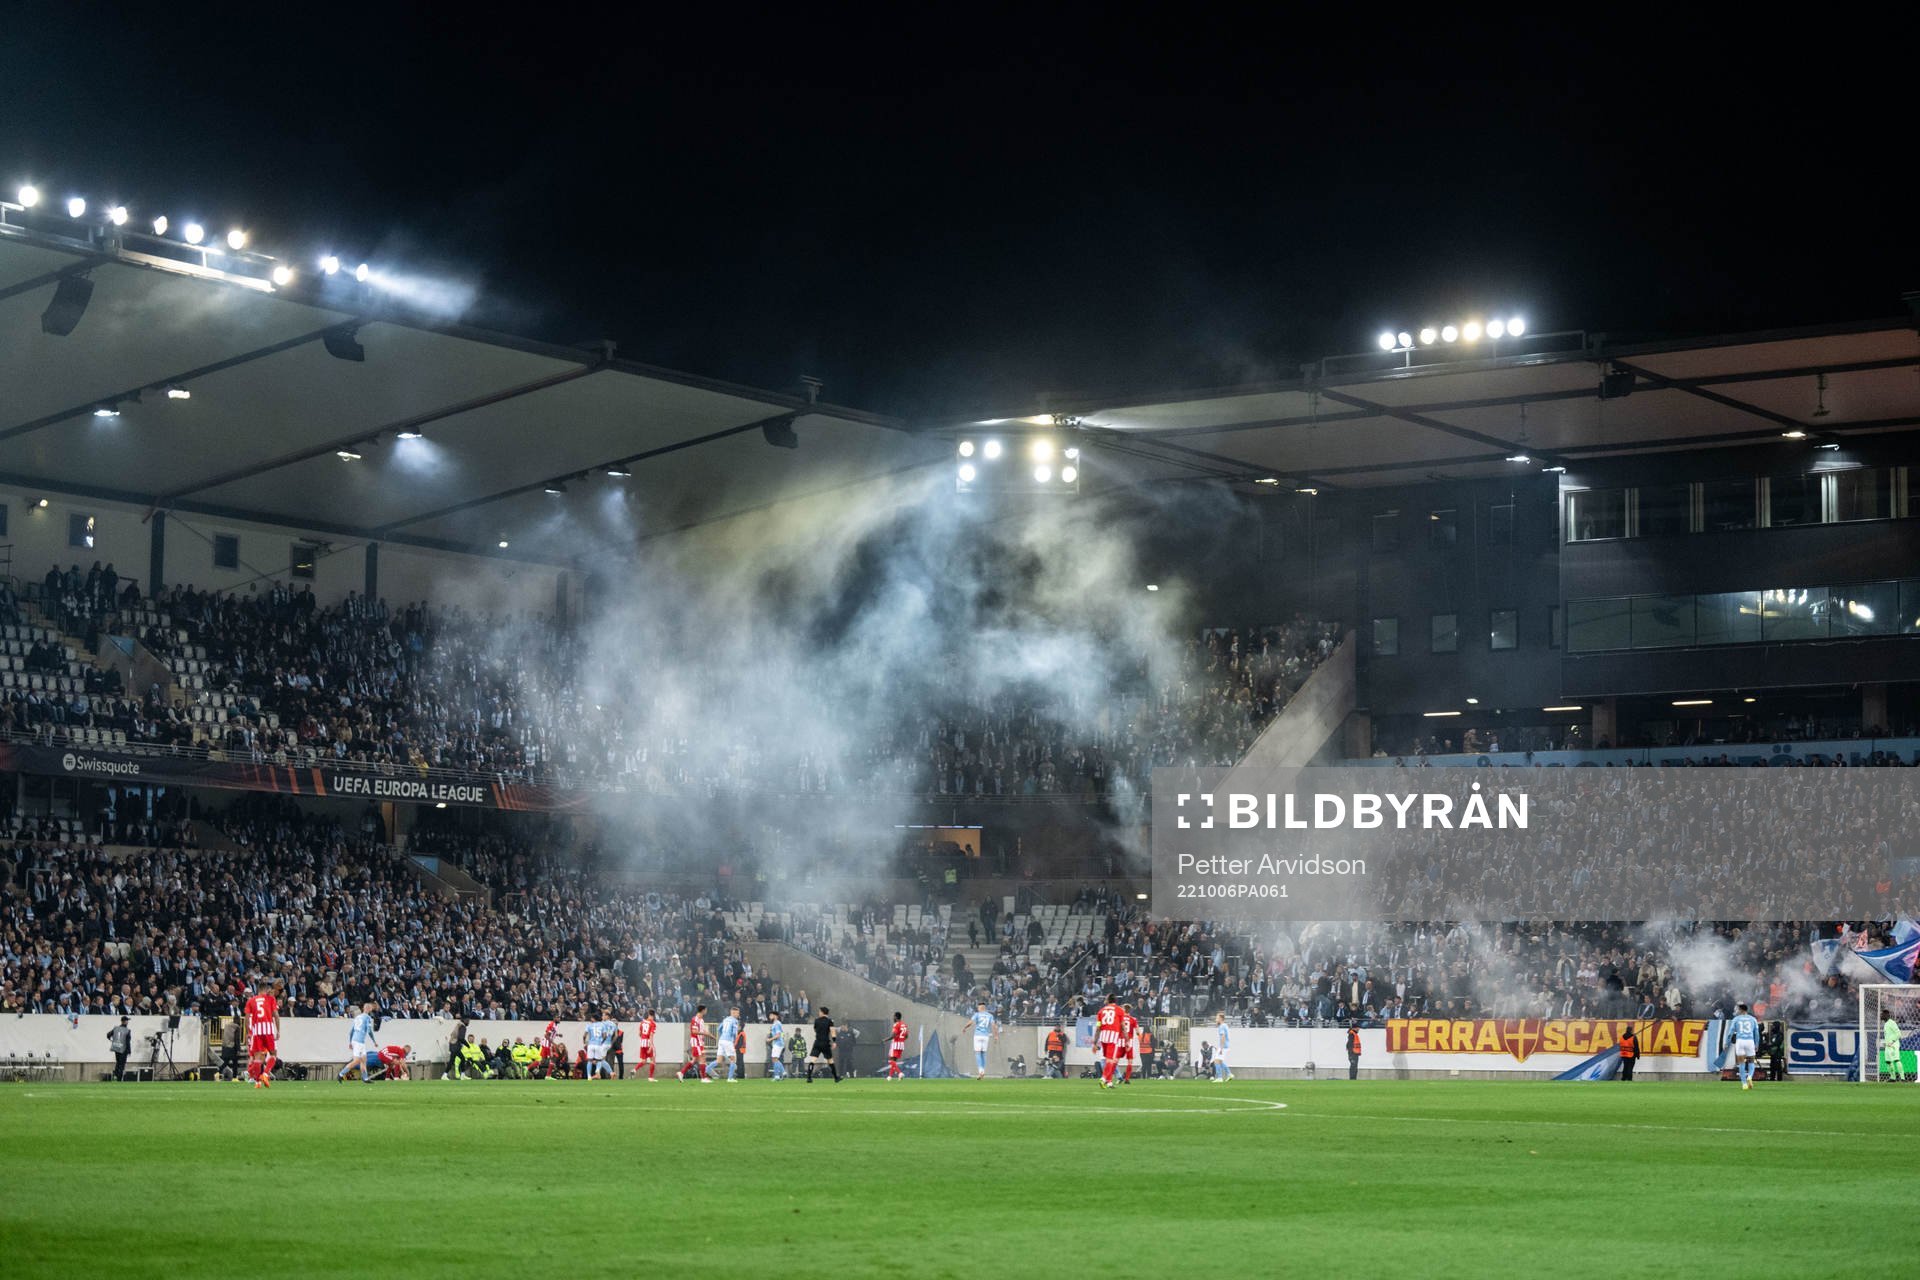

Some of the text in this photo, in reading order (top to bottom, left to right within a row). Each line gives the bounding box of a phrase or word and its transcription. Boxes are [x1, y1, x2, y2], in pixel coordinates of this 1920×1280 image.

[76, 756, 140, 776] Swissquote
[333, 776, 484, 802] UEFA EUROPA LEAGUE
[256, 1001, 265, 1018] 5
[1101, 1010, 1115, 1025] 28
[641, 1023, 650, 1035] 19
[979, 1017, 990, 1028] 21
[1738, 1021, 1752, 1033] 13
[1387, 1020, 1501, 1051] TERRA
